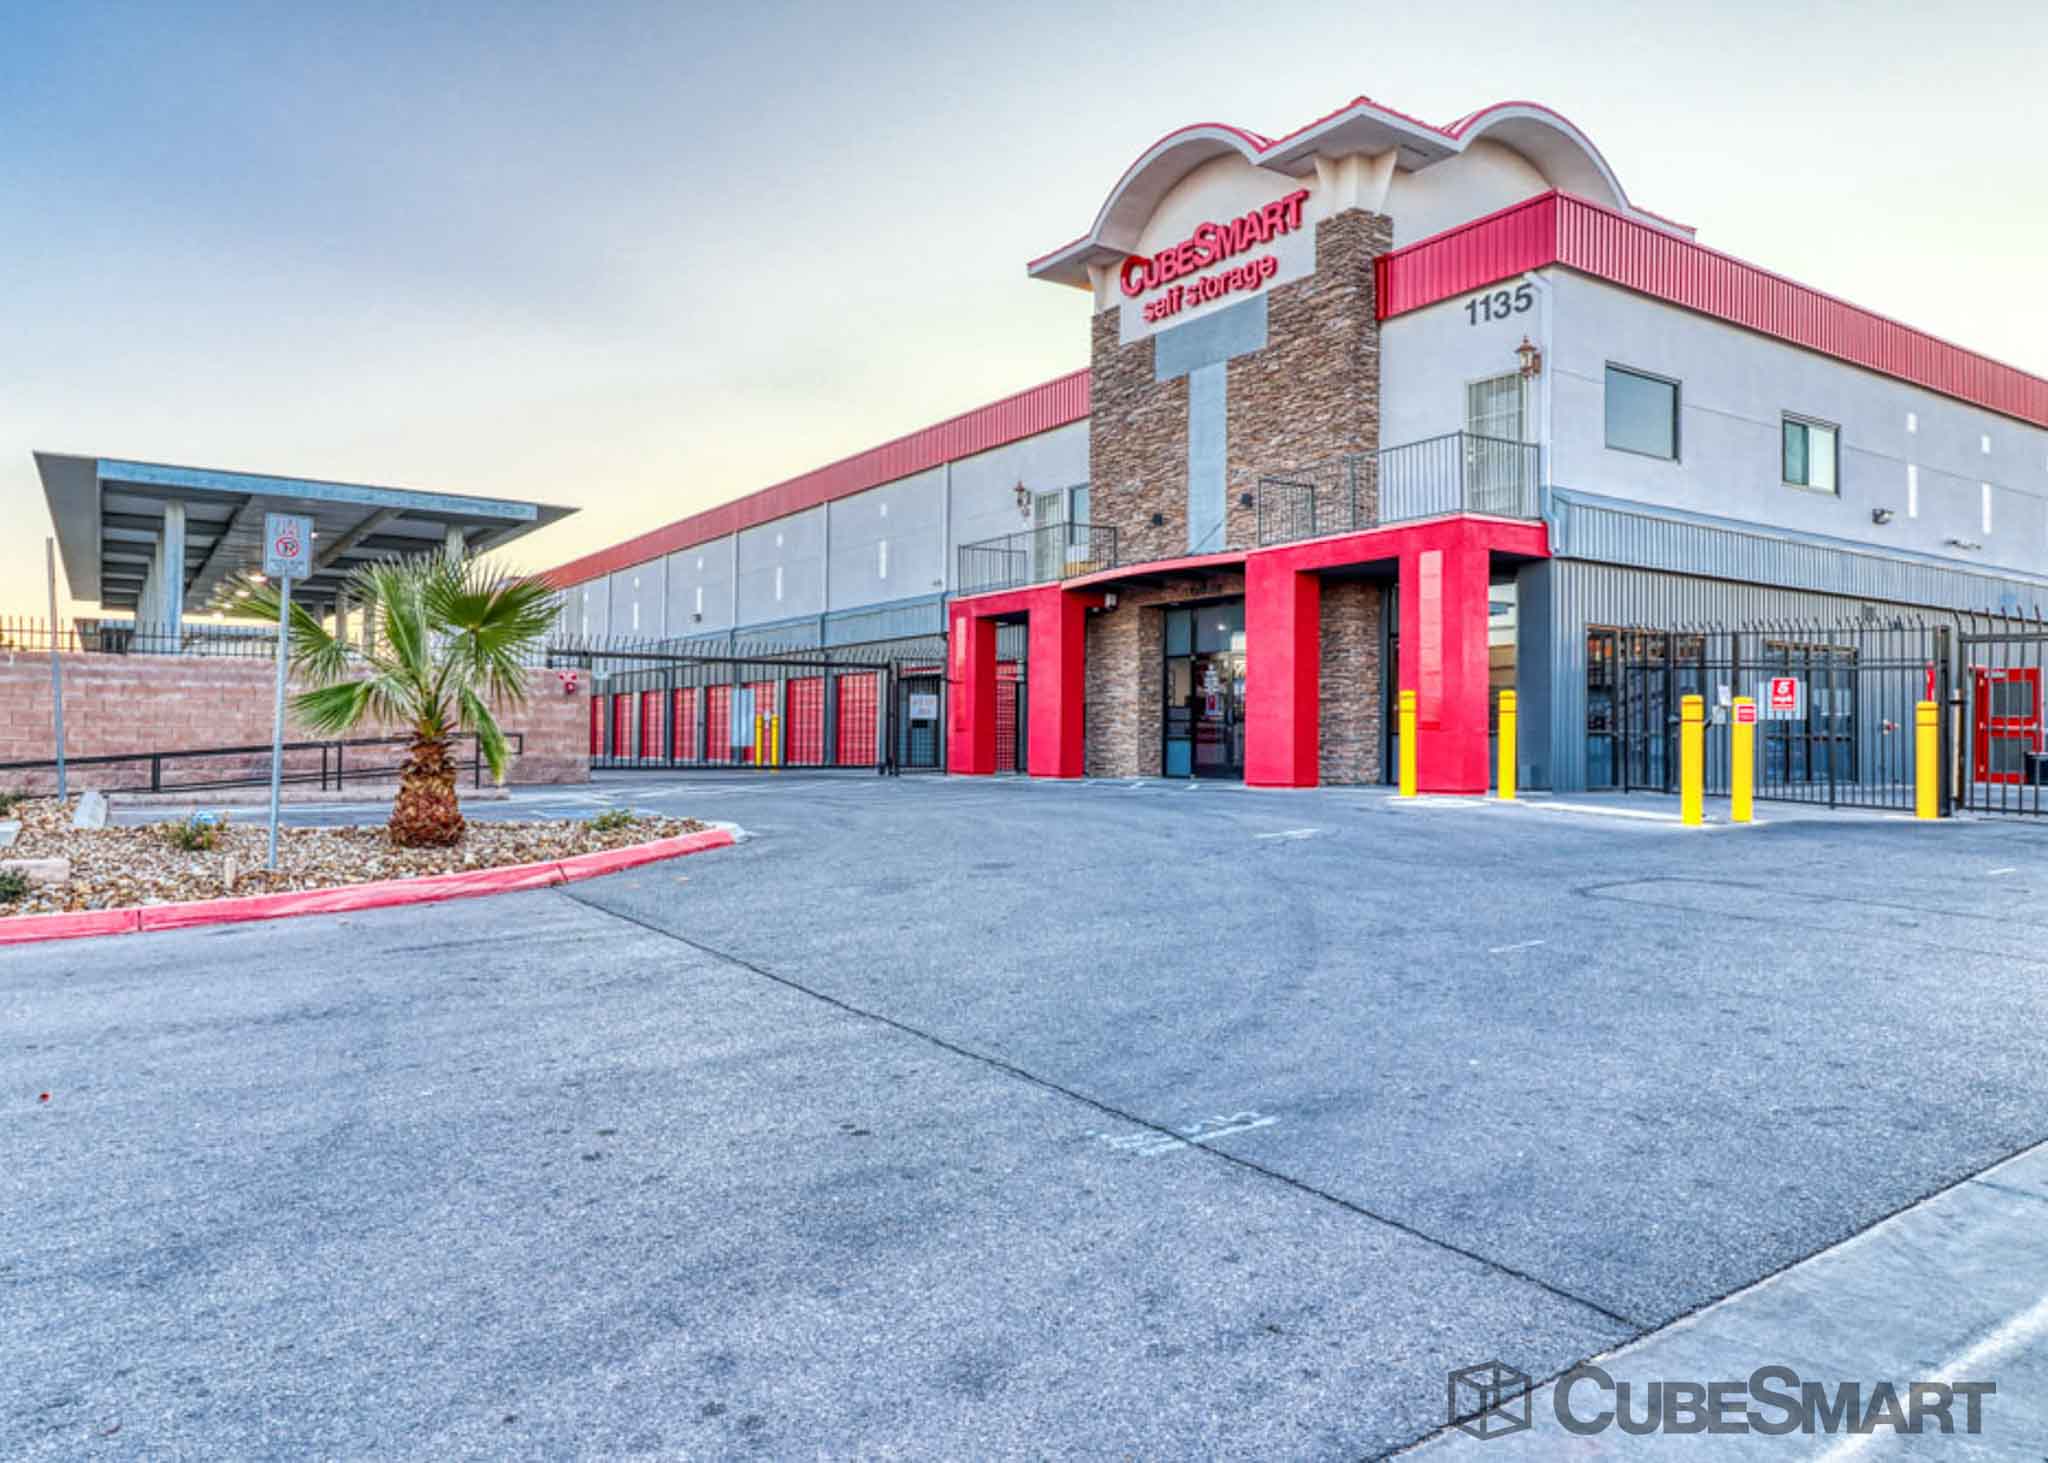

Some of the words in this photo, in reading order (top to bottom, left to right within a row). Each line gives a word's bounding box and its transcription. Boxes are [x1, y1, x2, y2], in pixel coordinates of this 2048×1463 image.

[1143, 284, 1183, 322] self
[1186, 256, 1278, 306] storage
[1464, 282, 1534, 326] 1135
